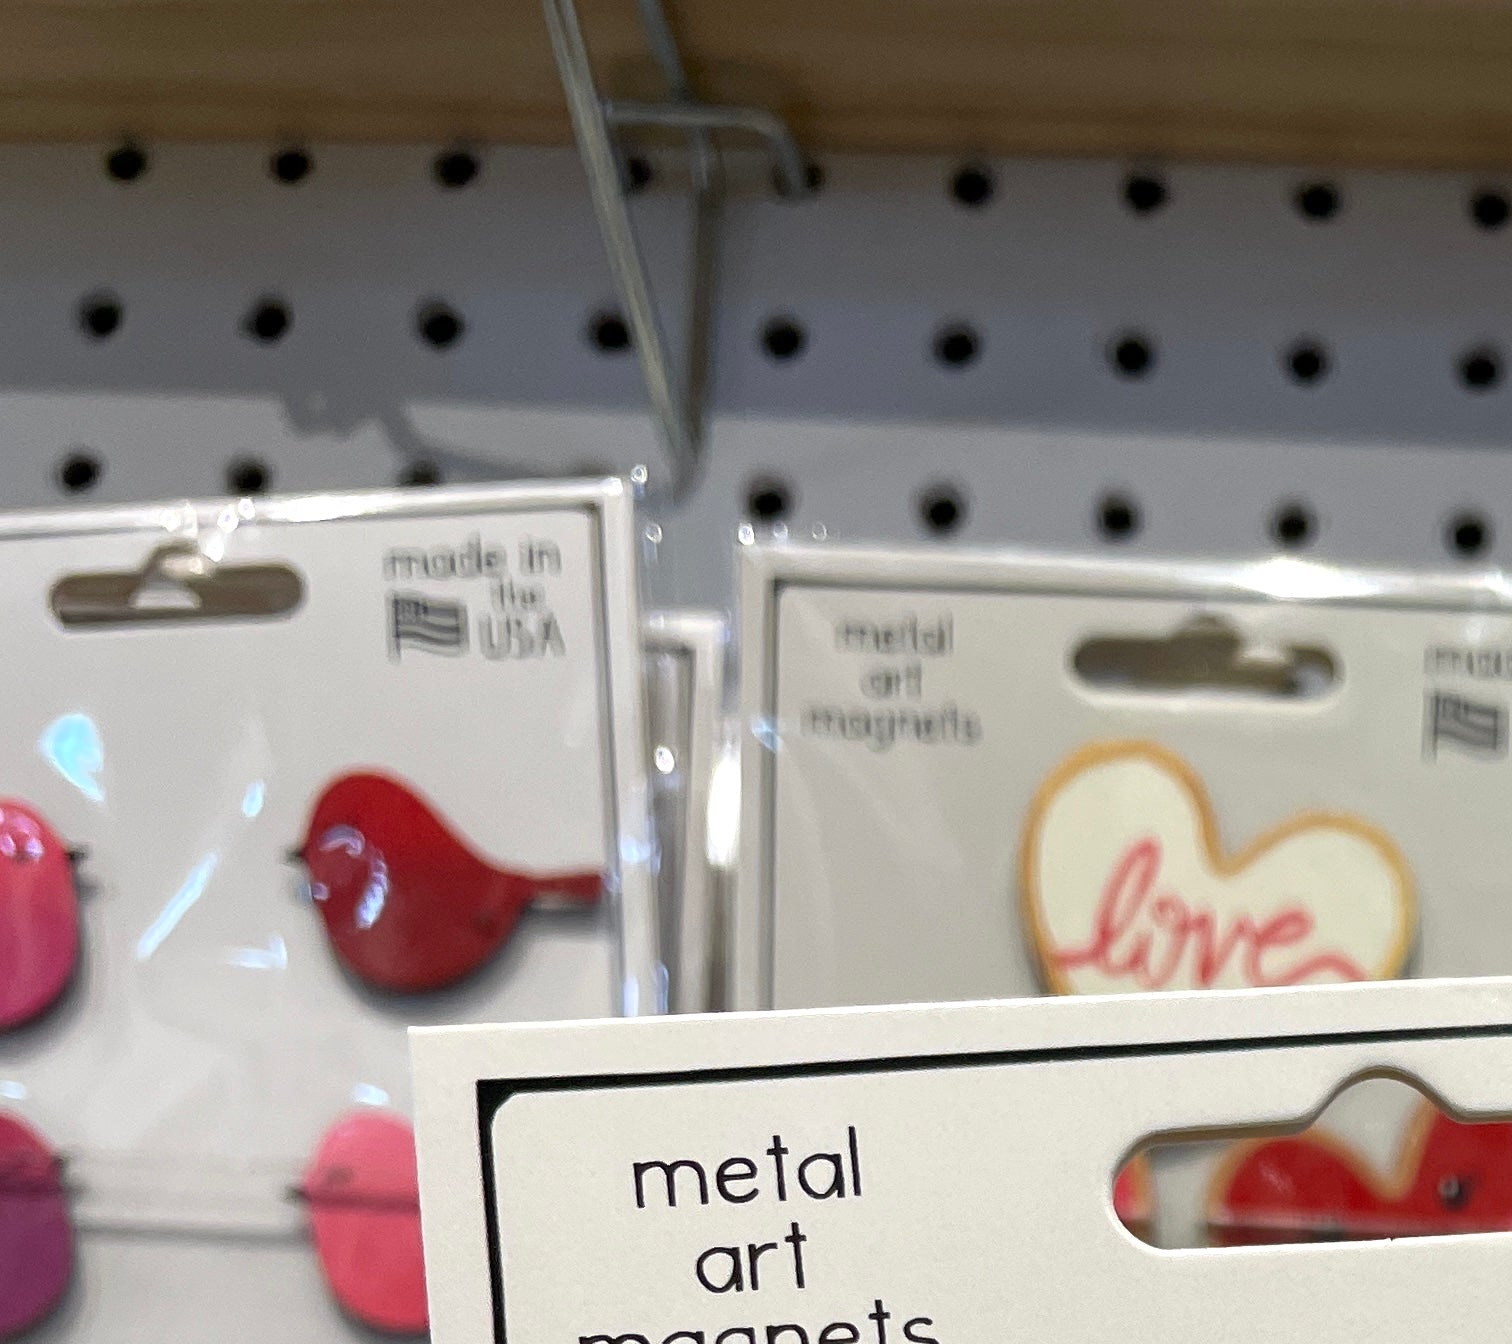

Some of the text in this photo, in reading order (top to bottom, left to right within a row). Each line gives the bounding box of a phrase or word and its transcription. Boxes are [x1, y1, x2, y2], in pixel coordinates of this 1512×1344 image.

[382, 533, 562, 581] made in
[478, 611, 566, 660] USA
[1048, 836, 1370, 988] love
[632, 1124, 863, 1209] metal
[696, 1220, 808, 1294] art
